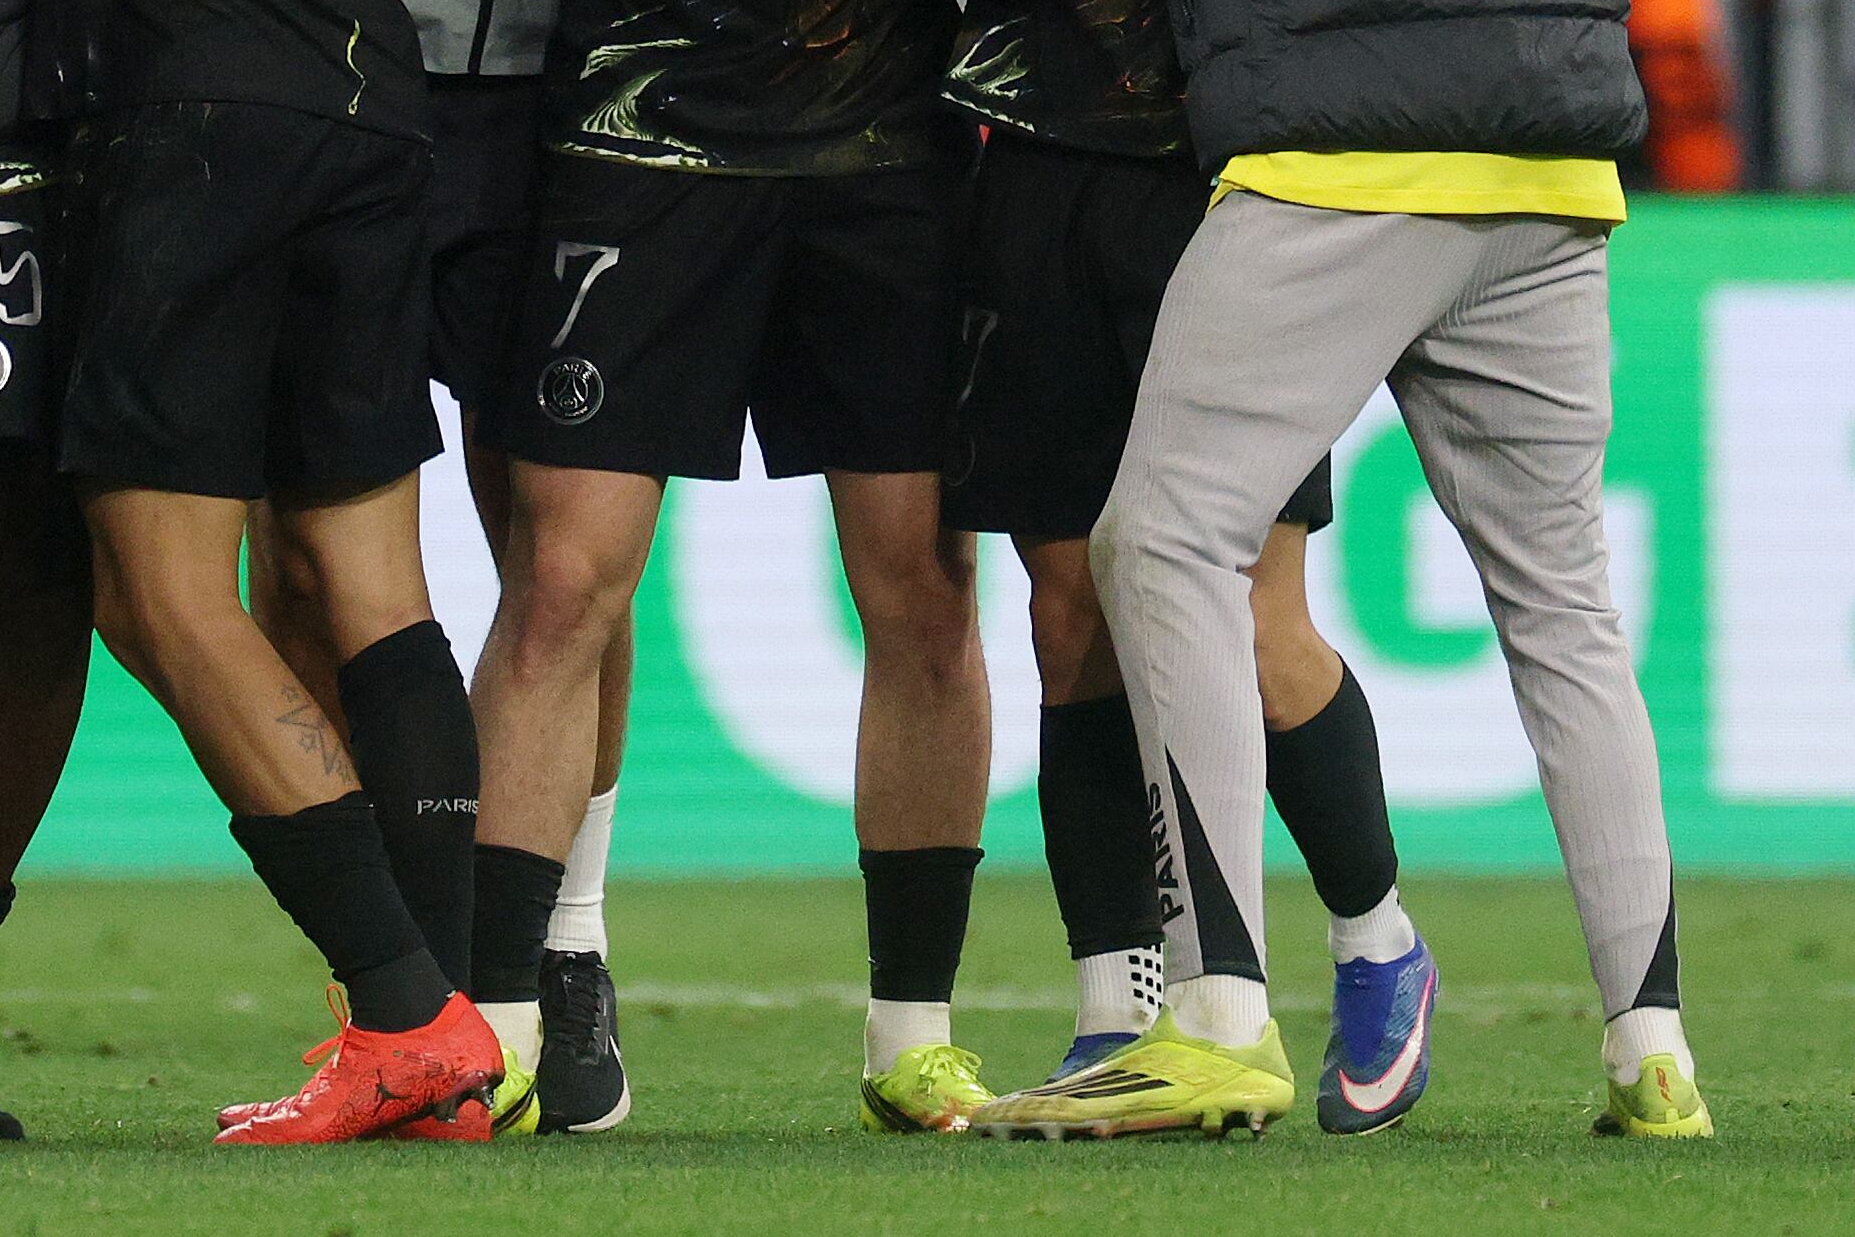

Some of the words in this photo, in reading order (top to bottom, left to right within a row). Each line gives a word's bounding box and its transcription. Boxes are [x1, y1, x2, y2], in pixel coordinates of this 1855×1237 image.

[553, 240, 621, 350] 7
[416, 798, 480, 816] PARIS
[1148, 782, 1185, 924] PARIS
